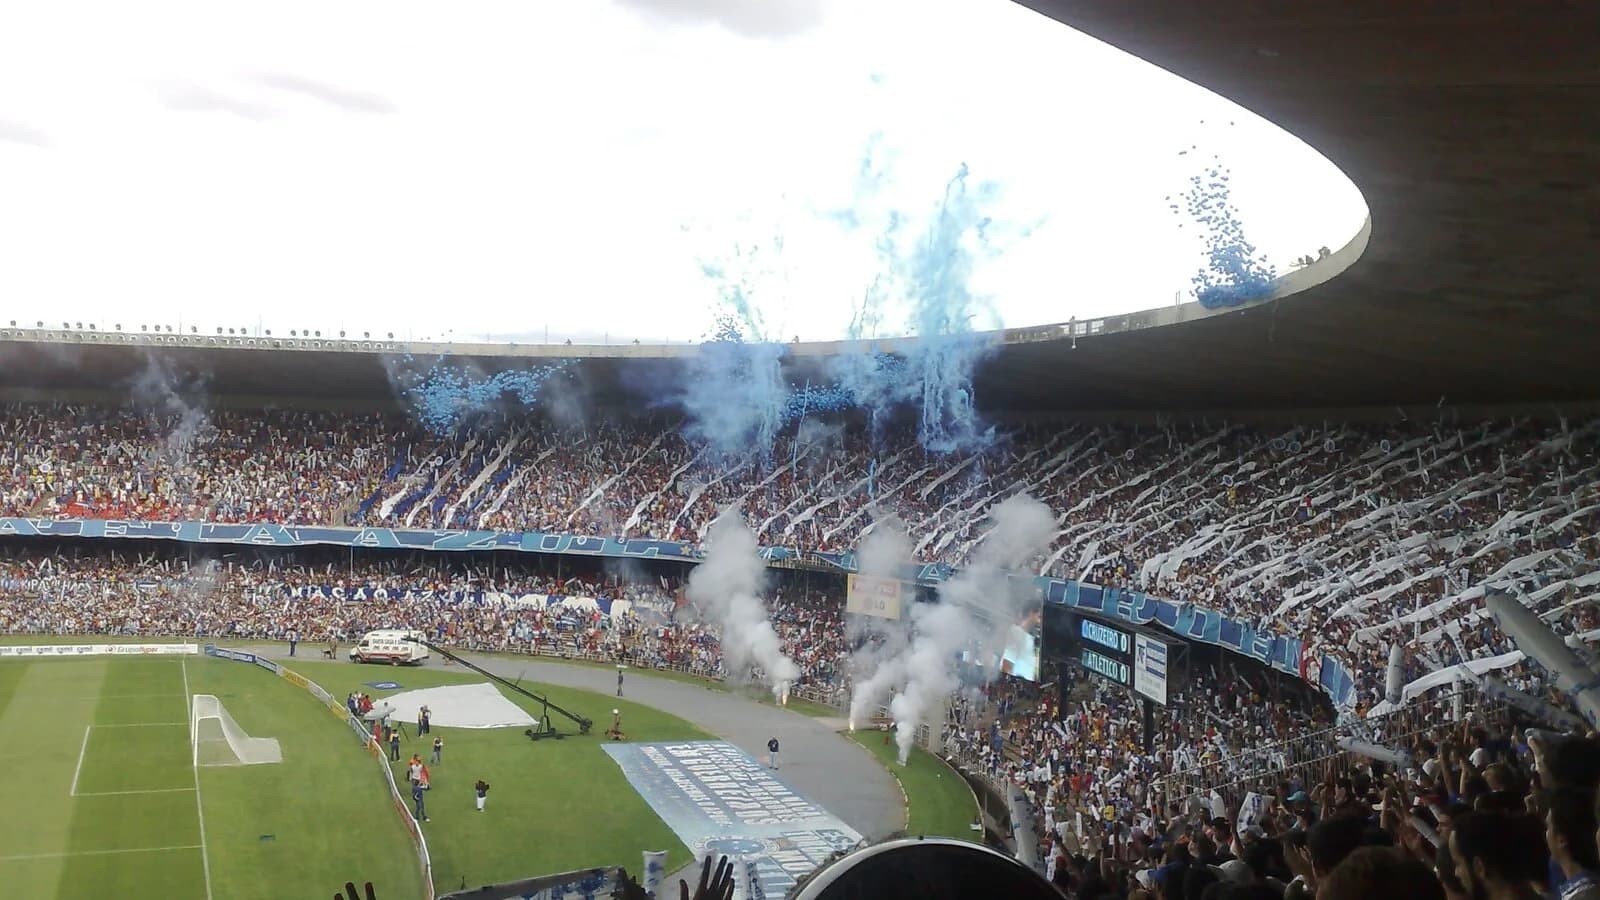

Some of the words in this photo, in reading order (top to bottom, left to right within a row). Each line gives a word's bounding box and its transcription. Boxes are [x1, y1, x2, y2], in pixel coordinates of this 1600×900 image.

[1088, 623, 1119, 649] CRUZEIRO
[1120, 634, 1128, 652] 0
[1120, 664, 1127, 683] 0
